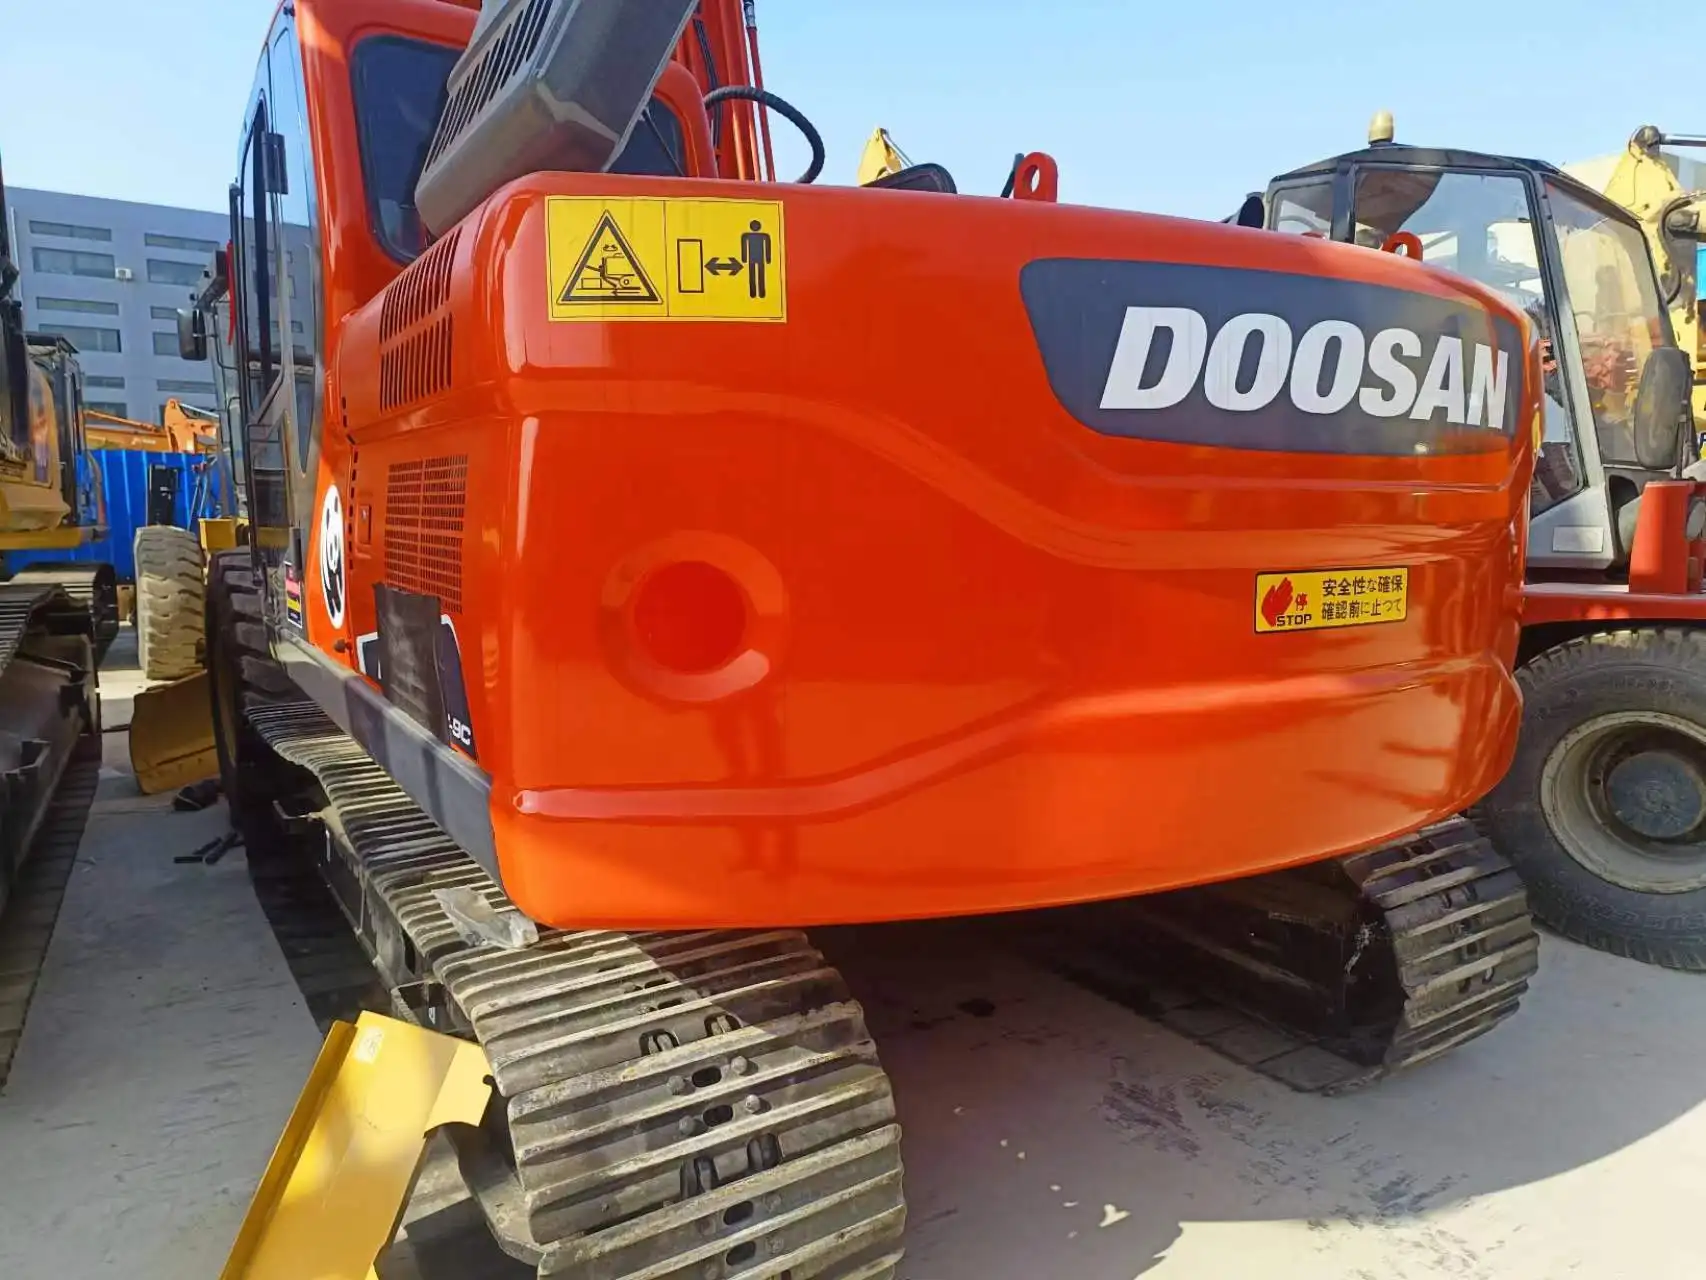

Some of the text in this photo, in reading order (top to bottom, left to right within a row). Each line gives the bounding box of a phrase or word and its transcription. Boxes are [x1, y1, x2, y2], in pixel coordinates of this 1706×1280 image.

[1100, 306, 1509, 429] DOOSAN
[1321, 575, 1403, 597] 安全性な確保
[1276, 613, 1312, 628] STOP
